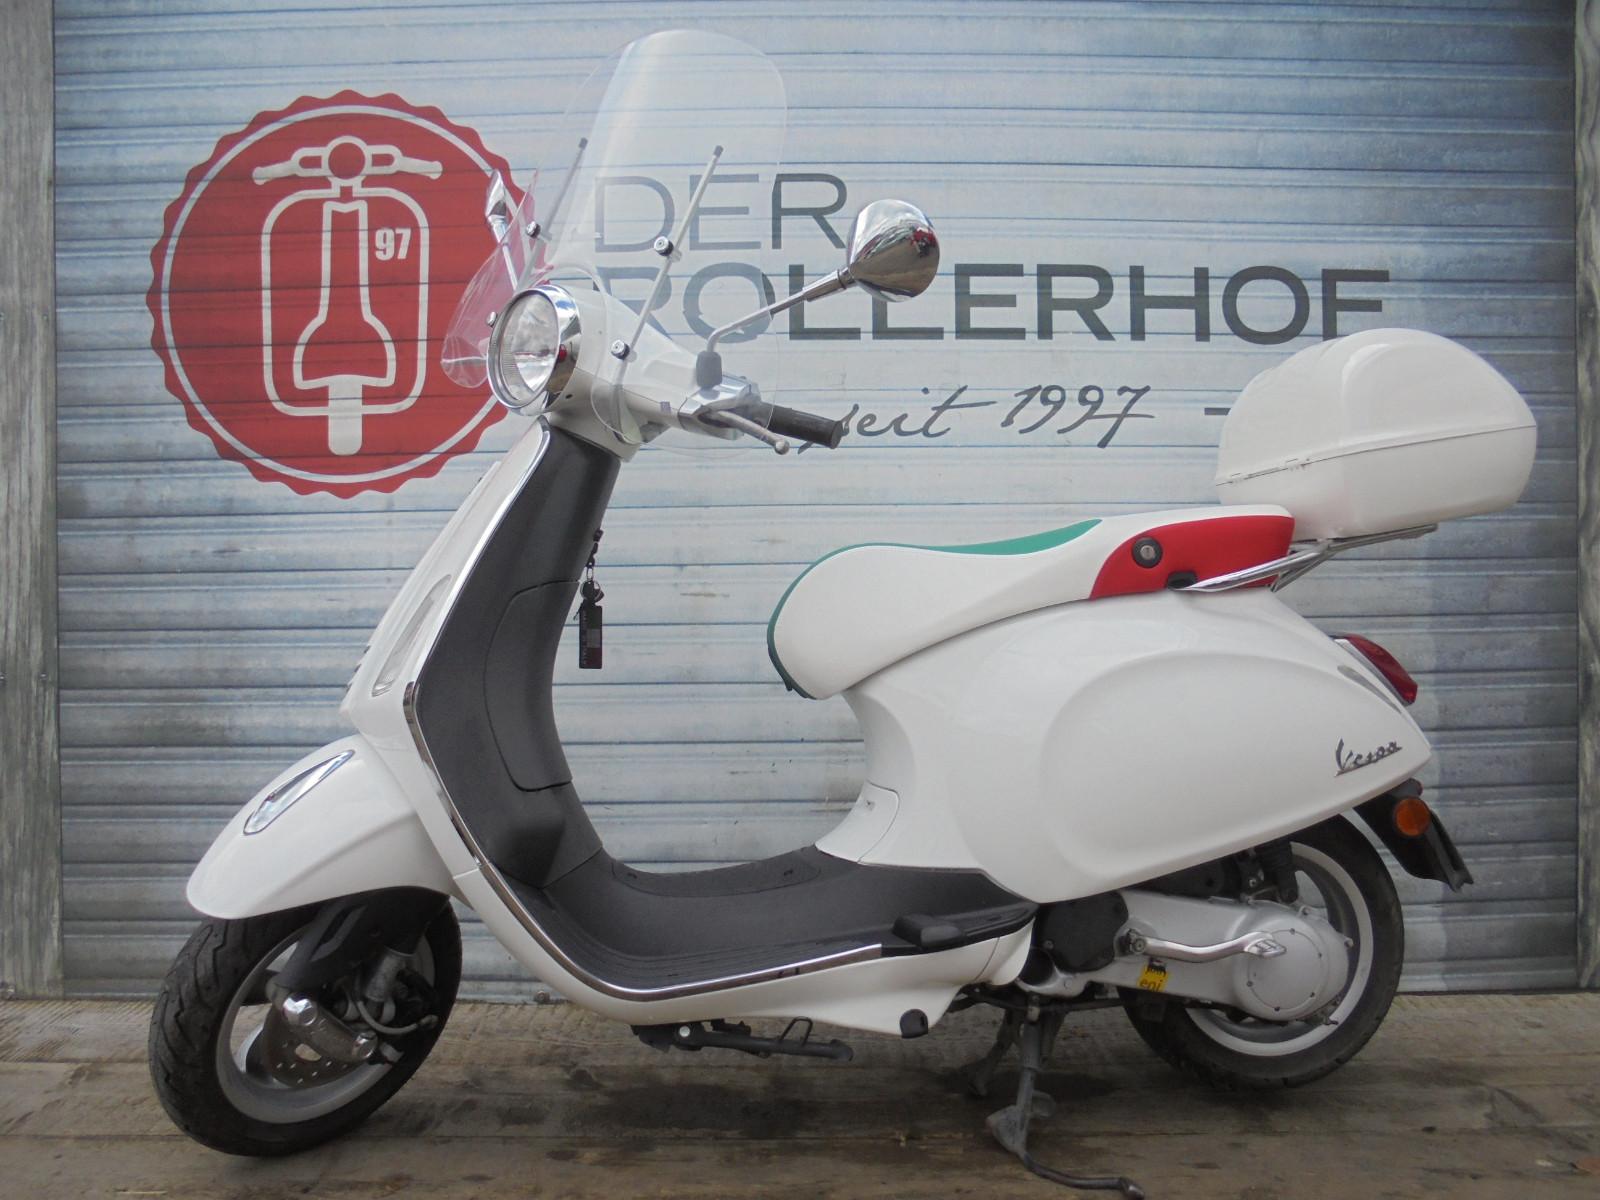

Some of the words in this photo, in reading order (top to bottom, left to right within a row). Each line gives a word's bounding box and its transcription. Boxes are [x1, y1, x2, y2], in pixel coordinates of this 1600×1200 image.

[375, 227, 412, 261] 97
[594, 173, 847, 252] DER
[593, 262, 1390, 345] ROLLERHOF
[1001, 384, 1155, 448] 1997
[1334, 738, 1403, 778] Vespa
